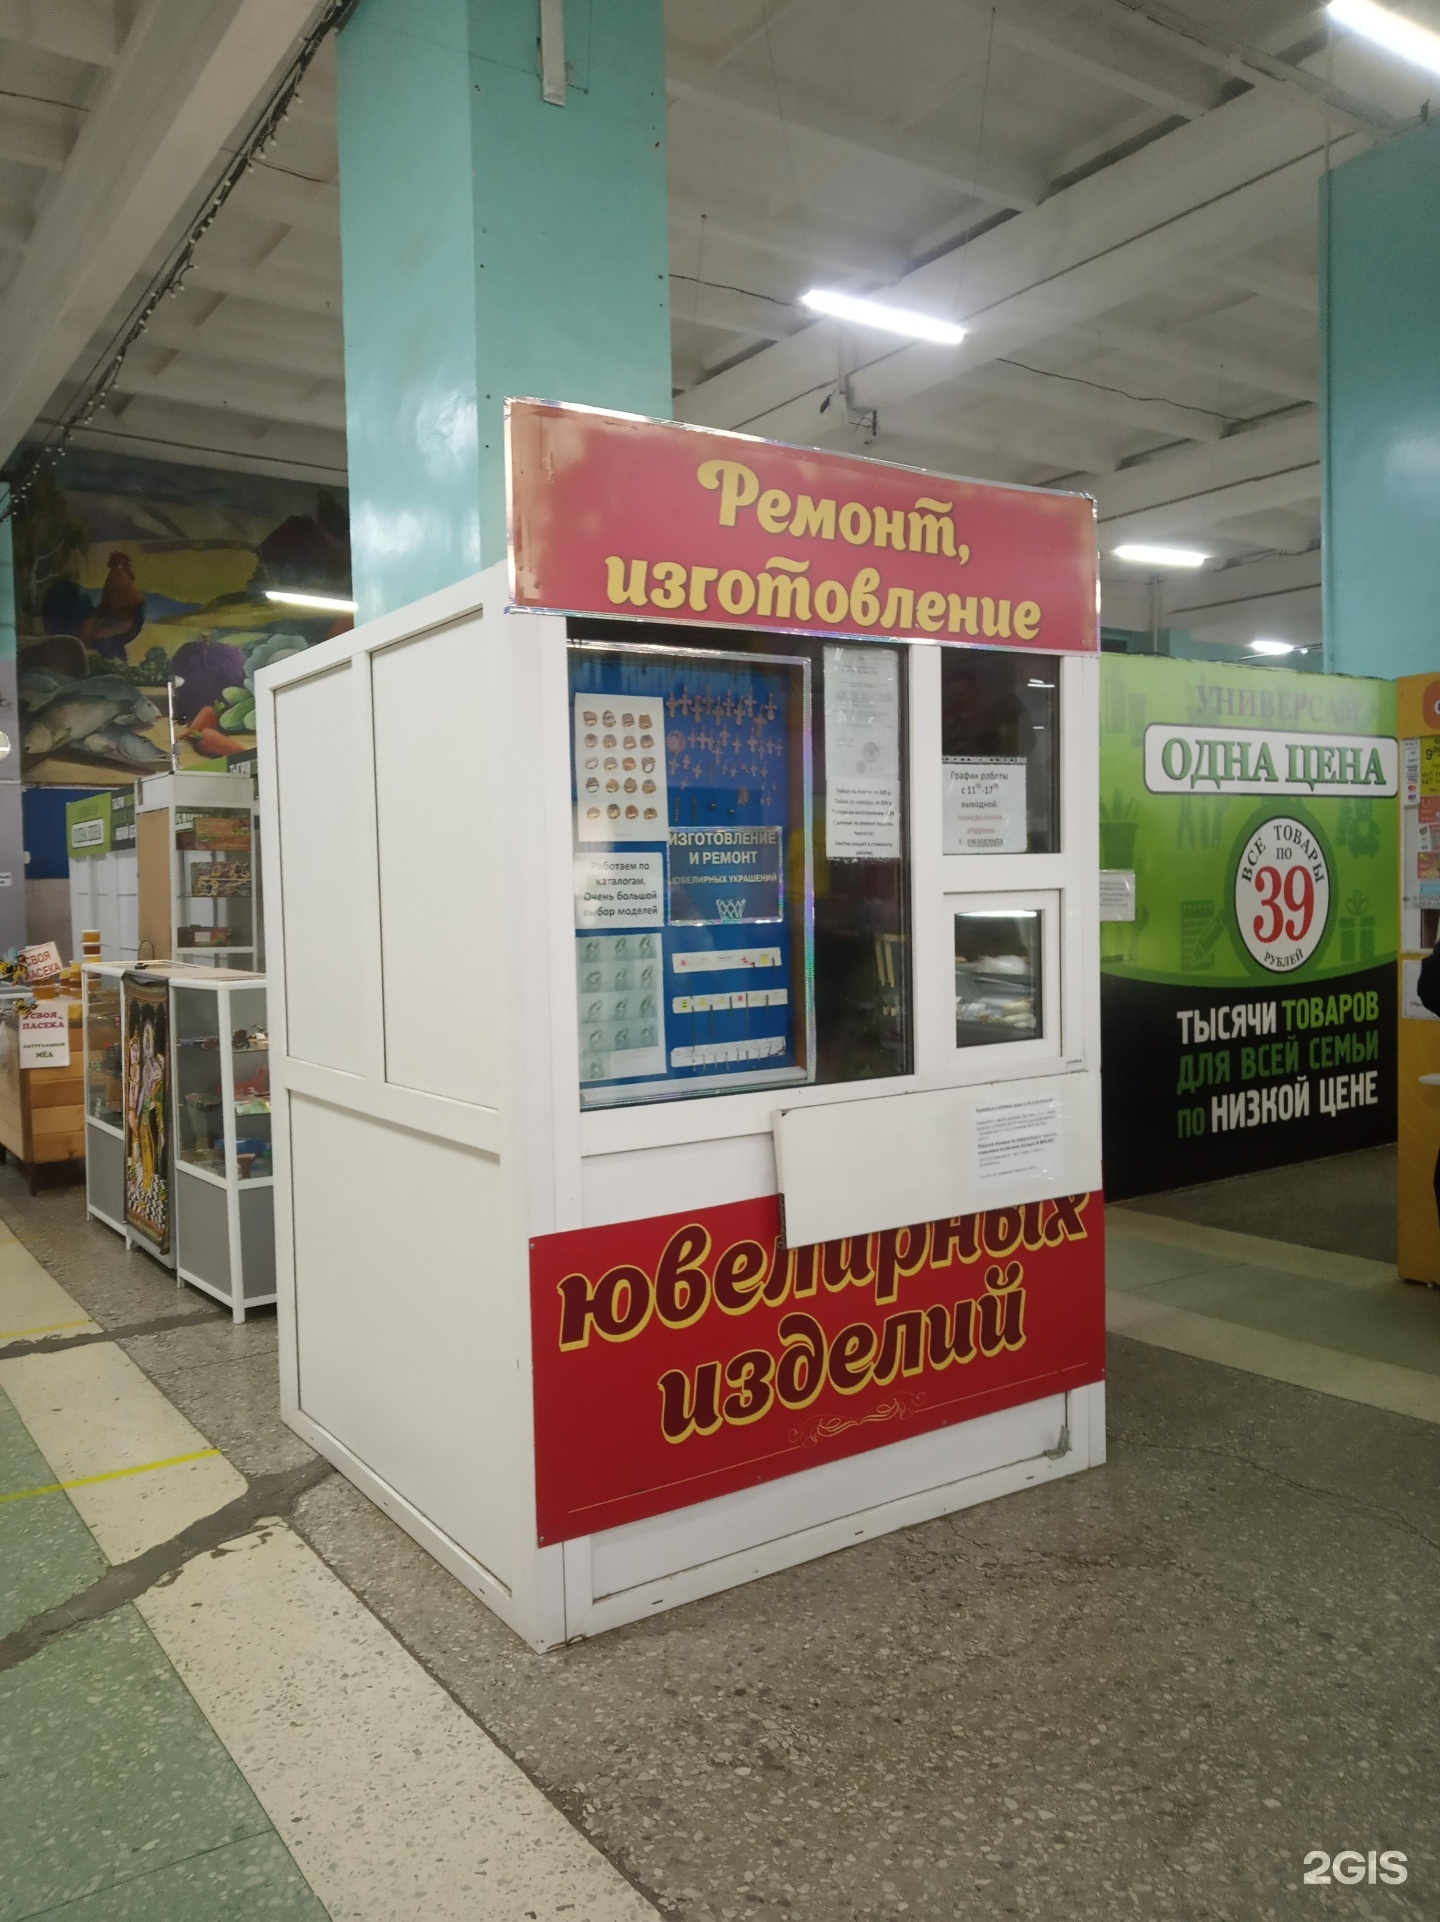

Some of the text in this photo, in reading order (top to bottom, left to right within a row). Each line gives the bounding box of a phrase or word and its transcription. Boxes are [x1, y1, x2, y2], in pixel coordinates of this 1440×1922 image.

[697, 459, 970, 564] Ремонт,
[604, 556, 1042, 640] изготовление
[950, 771, 1009, 781] График работы
[1162, 737, 1279, 790] ОДНА
[1285, 744, 1387, 792] ЦЕНА
[668, 831, 777, 846] ИЗГОТОВЛЕНИЕ
[1241, 824, 1325, 884] ВСЕ ТОВАРЫ
[1275, 847, 1293, 861] ПО
[689, 851, 758, 865] И РЕМОНТ
[583, 891, 657, 901] Очень большой
[670, 873, 777, 885] ЮВЕЛИРНЫХ УКРАШЕНИЙ
[583, 905, 658, 917] выбор моделей
[1253, 865, 1315, 943] 39
[1263, 947, 1304, 968] РУБЛЕЙ
[22, 1022, 64, 1030] ПАСЕКА
[30, 1011, 57, 1019] СВОЯ
[1176, 991, 1379, 1044] ТЫСЯЧИ ТОВАРОВ
[1176, 1030, 1379, 1096] ДЛЯ ВСЕЙ СЕМЬИ
[1177, 1070, 1379, 1139] ПО НИЗКОЙ ЦЕНЕ
[557, 1192, 1092, 1352] ювелирных
[657, 1261, 1027, 1445] изделий
